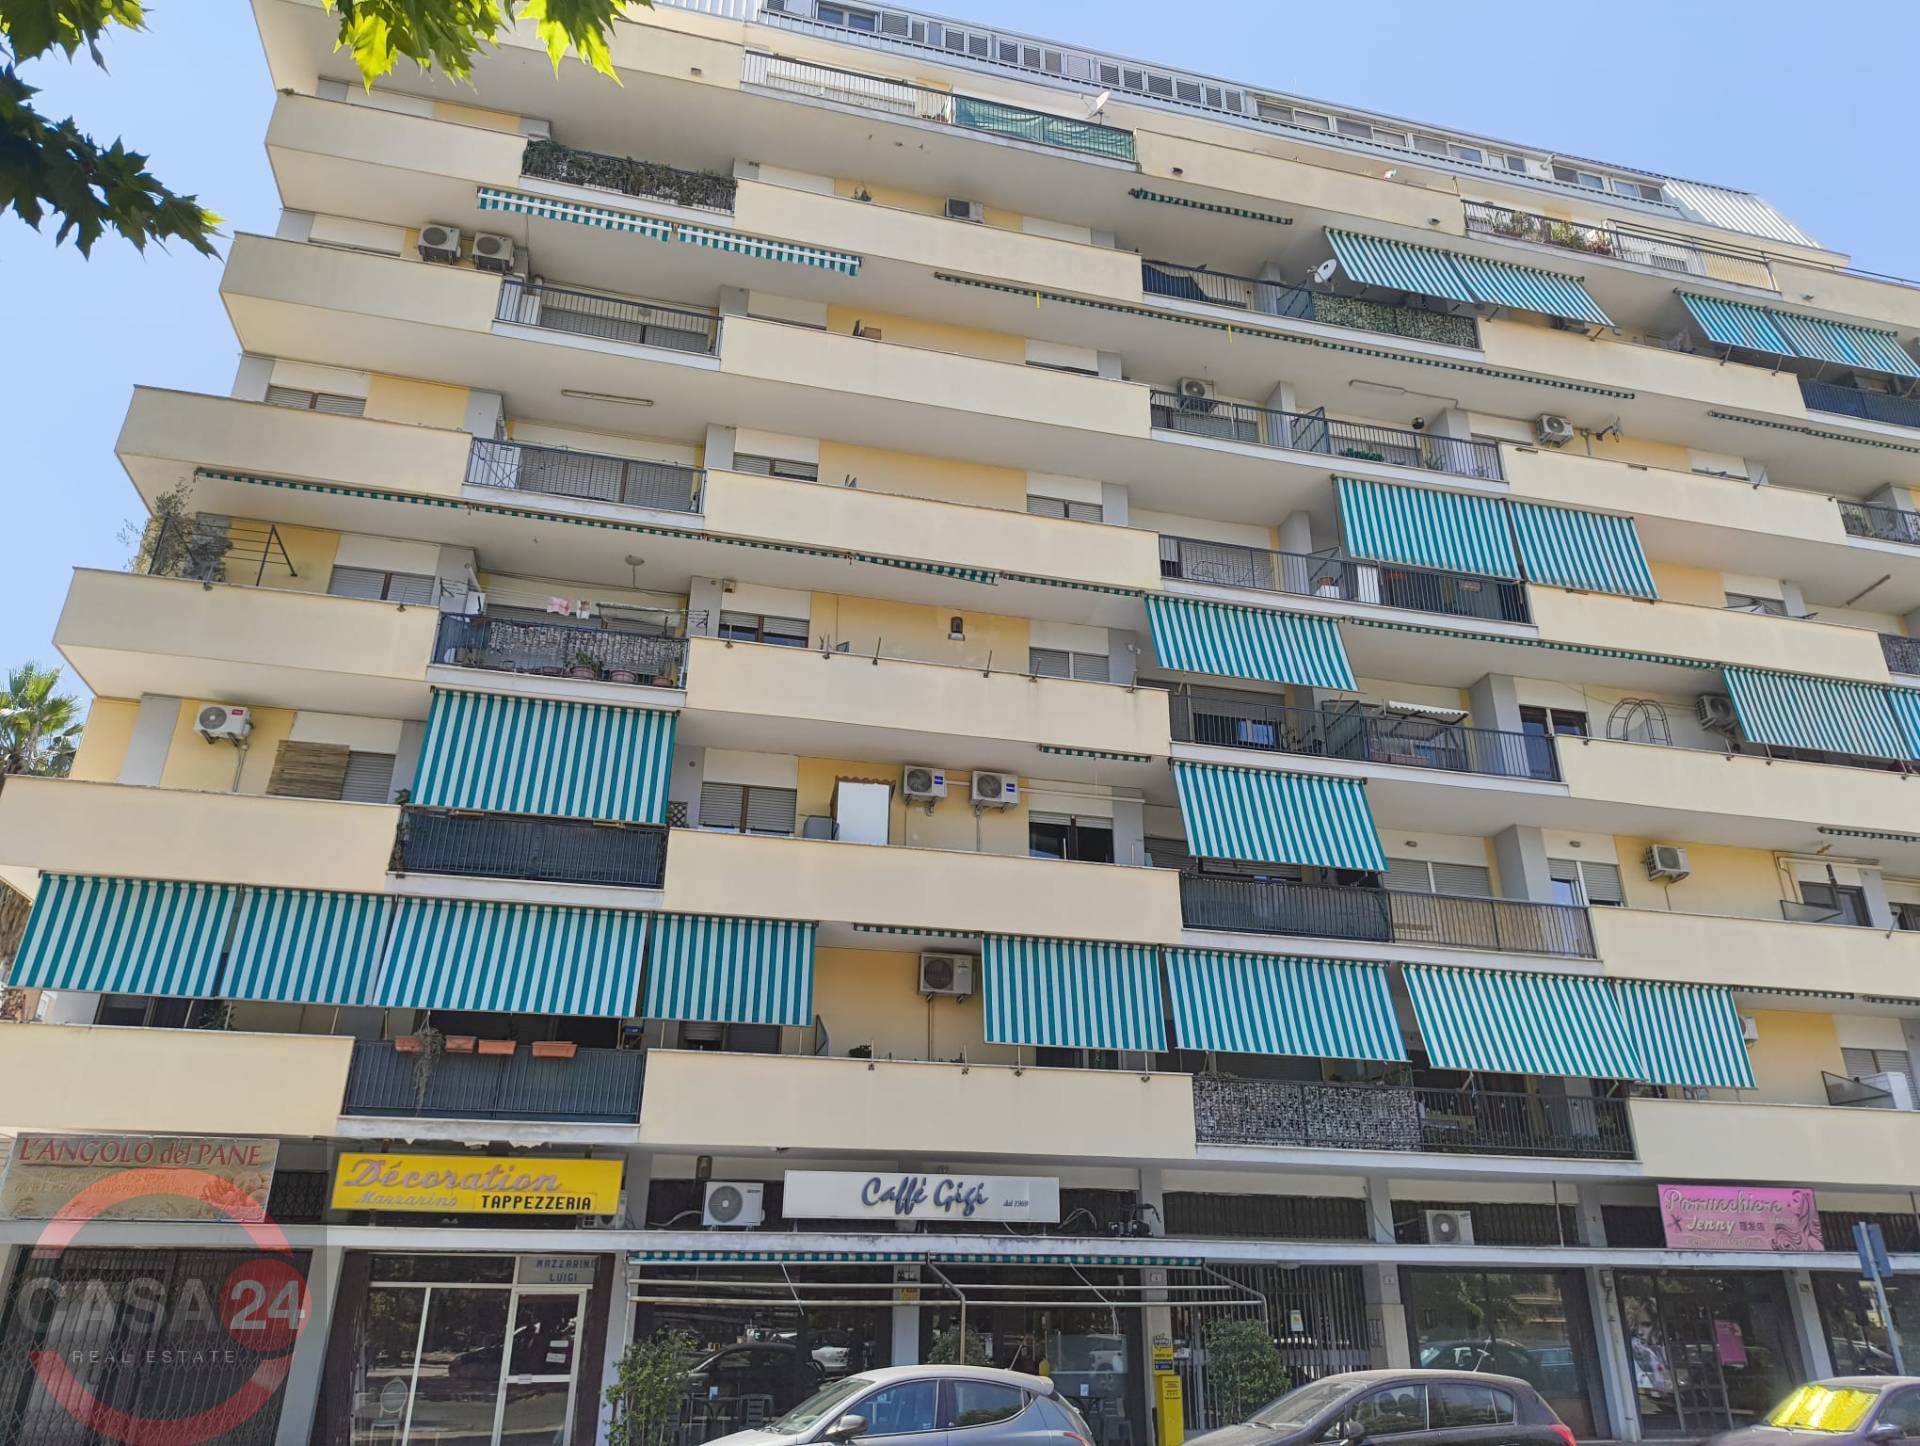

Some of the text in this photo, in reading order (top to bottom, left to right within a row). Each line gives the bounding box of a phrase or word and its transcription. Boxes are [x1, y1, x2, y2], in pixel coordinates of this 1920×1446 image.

[19, 1138, 262, 1167] L'ANGOLO del PANE
[343, 1158, 563, 1192] Décoration
[481, 1194, 592, 1211] TAPPEZZERIA
[933, 1179, 989, 1217] Gigi
[1664, 1188, 1783, 1215] Parrucchiere
[1687, 1216, 1736, 1236] Jenny
[549, 1272, 578, 1282] LUIGI
